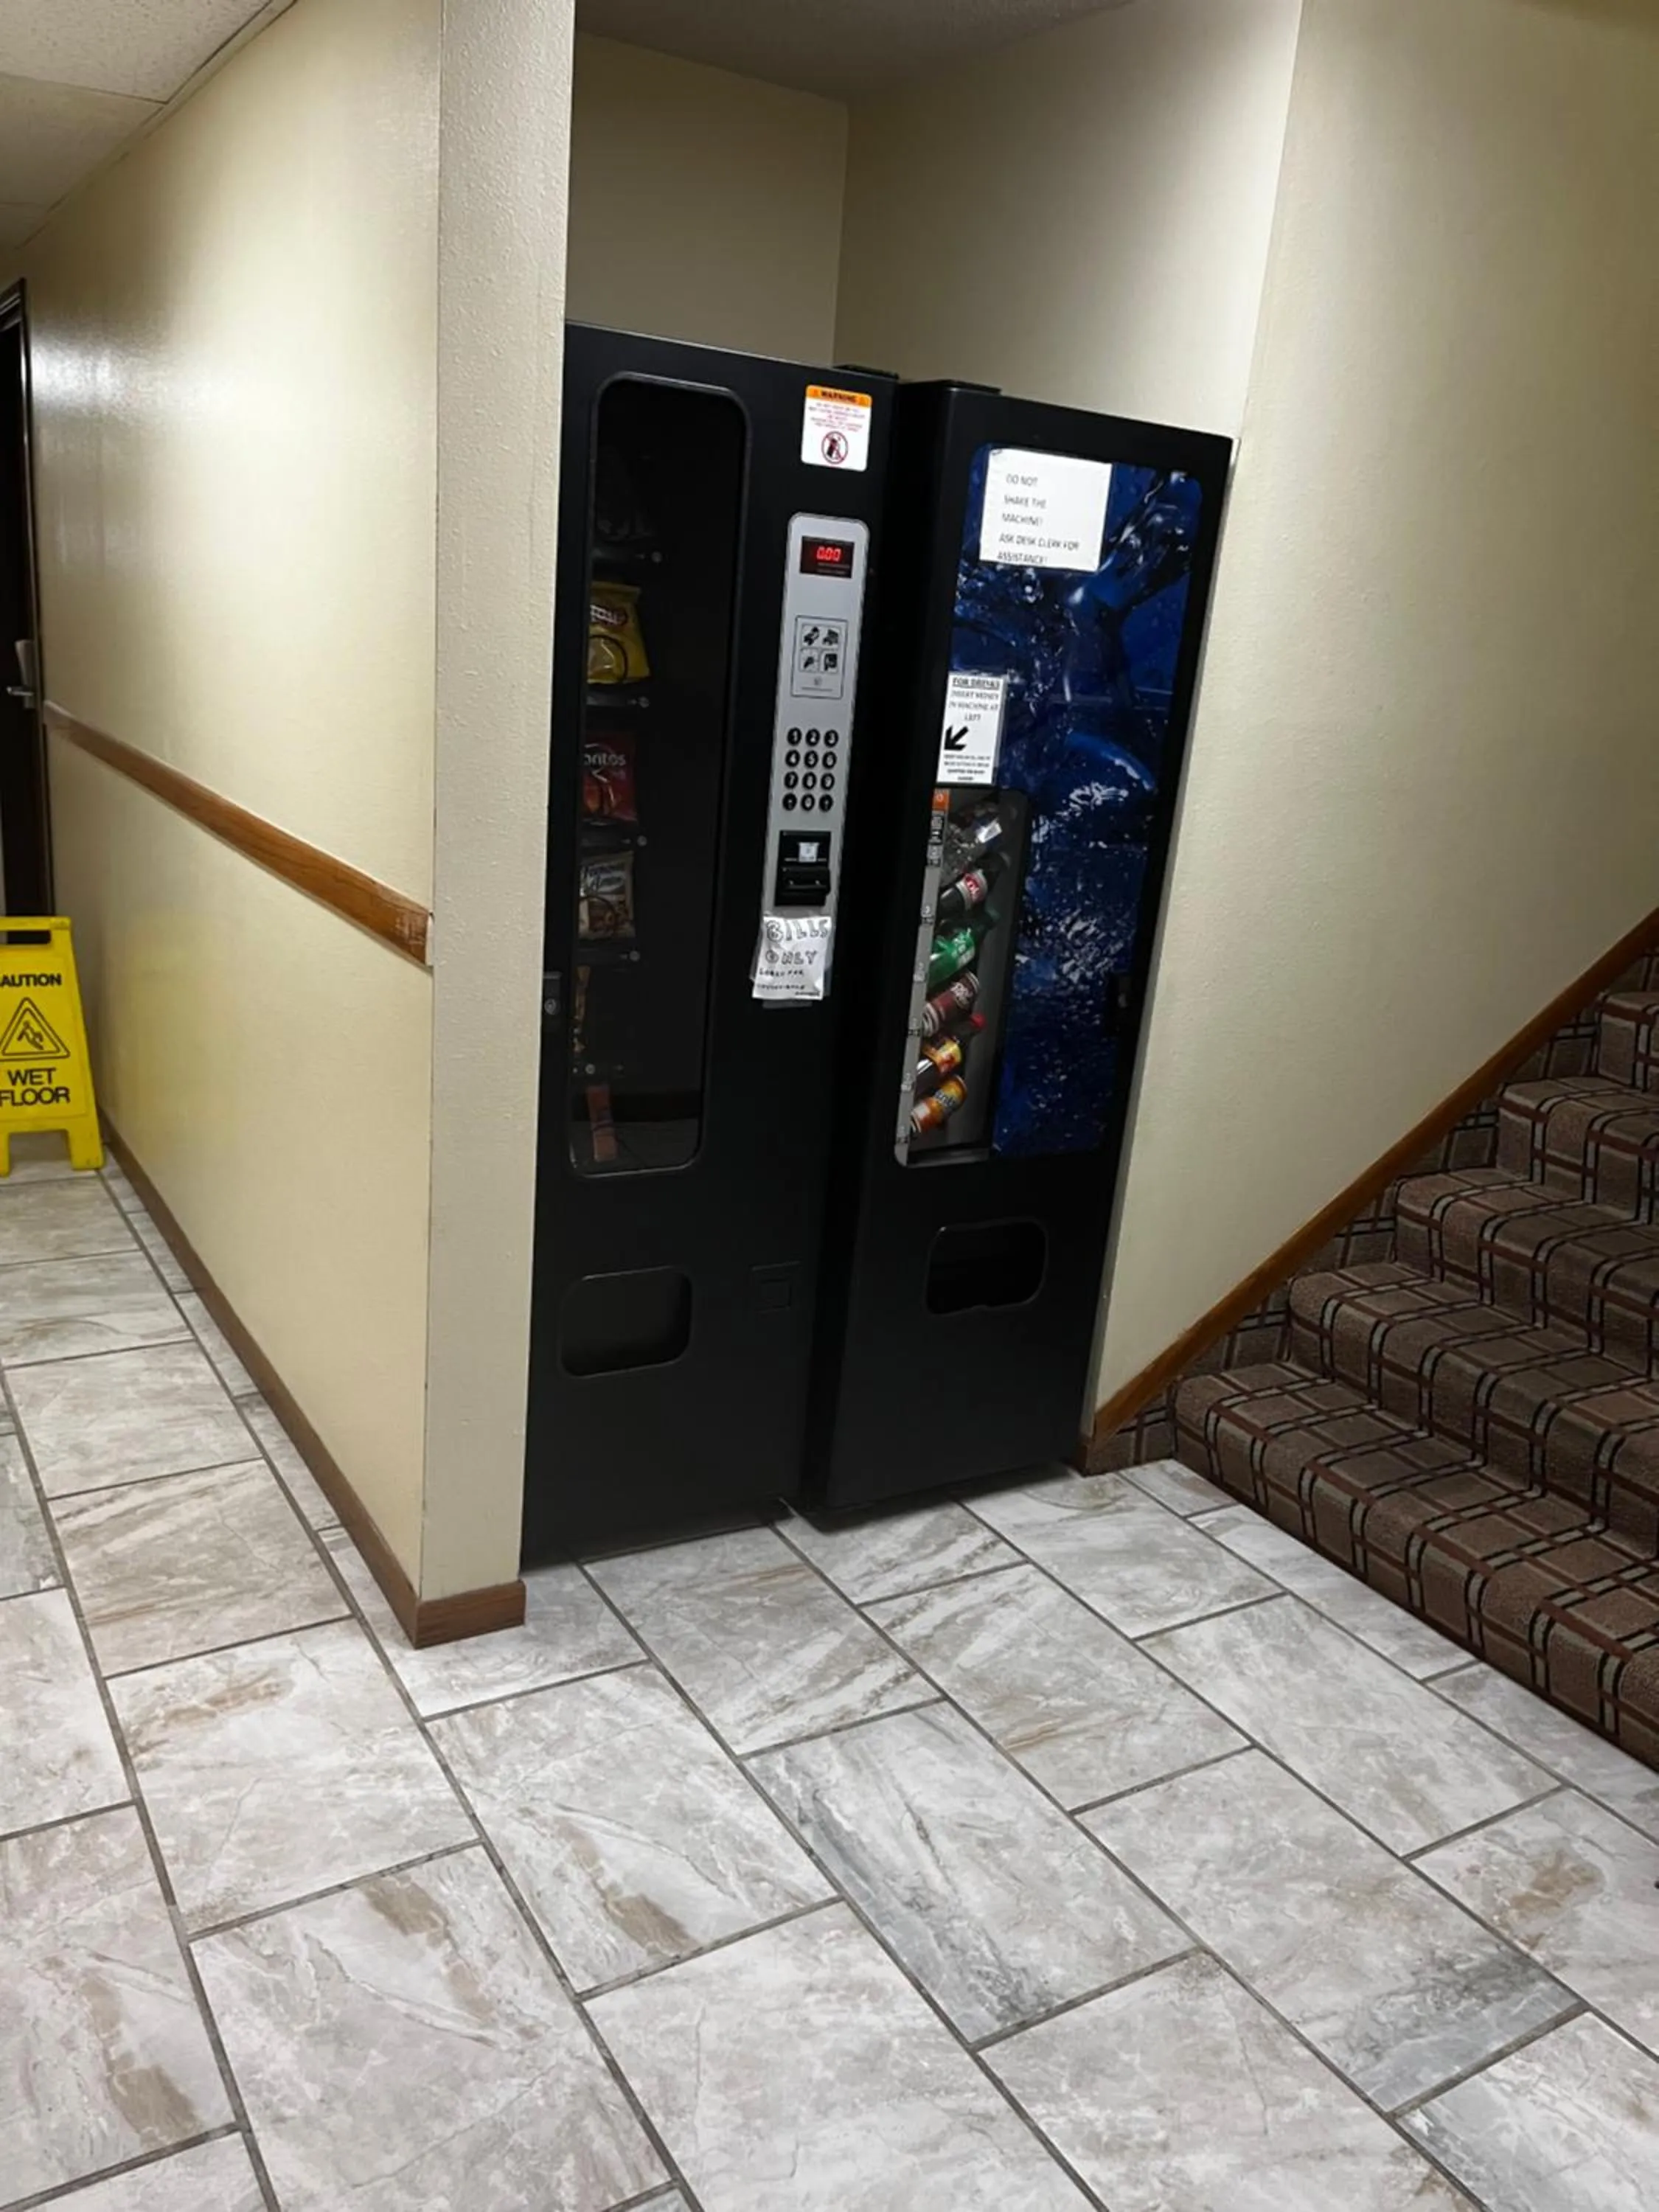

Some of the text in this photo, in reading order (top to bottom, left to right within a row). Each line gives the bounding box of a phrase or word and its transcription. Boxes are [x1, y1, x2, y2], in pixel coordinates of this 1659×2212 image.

[821, 391, 856, 403] WARNING
[1006, 473, 1038, 487] DO NOT
[1004, 495, 1046, 509] SHAKE THE
[999, 533, 1079, 551] ASK DESK CLERK FOR
[953, 677, 969, 687] FOR
[975, 692, 998, 700] MONEY
[958, 701, 988, 710] MACHINE
[964, 713, 981, 721] LEFT
[583, 752, 627, 766] oritos
[765, 949, 818, 965] ONLY
[0, 973, 62, 988] AUTION
[8, 1067, 57, 1086] WET
[0, 1087, 71, 1107] FLOOR
